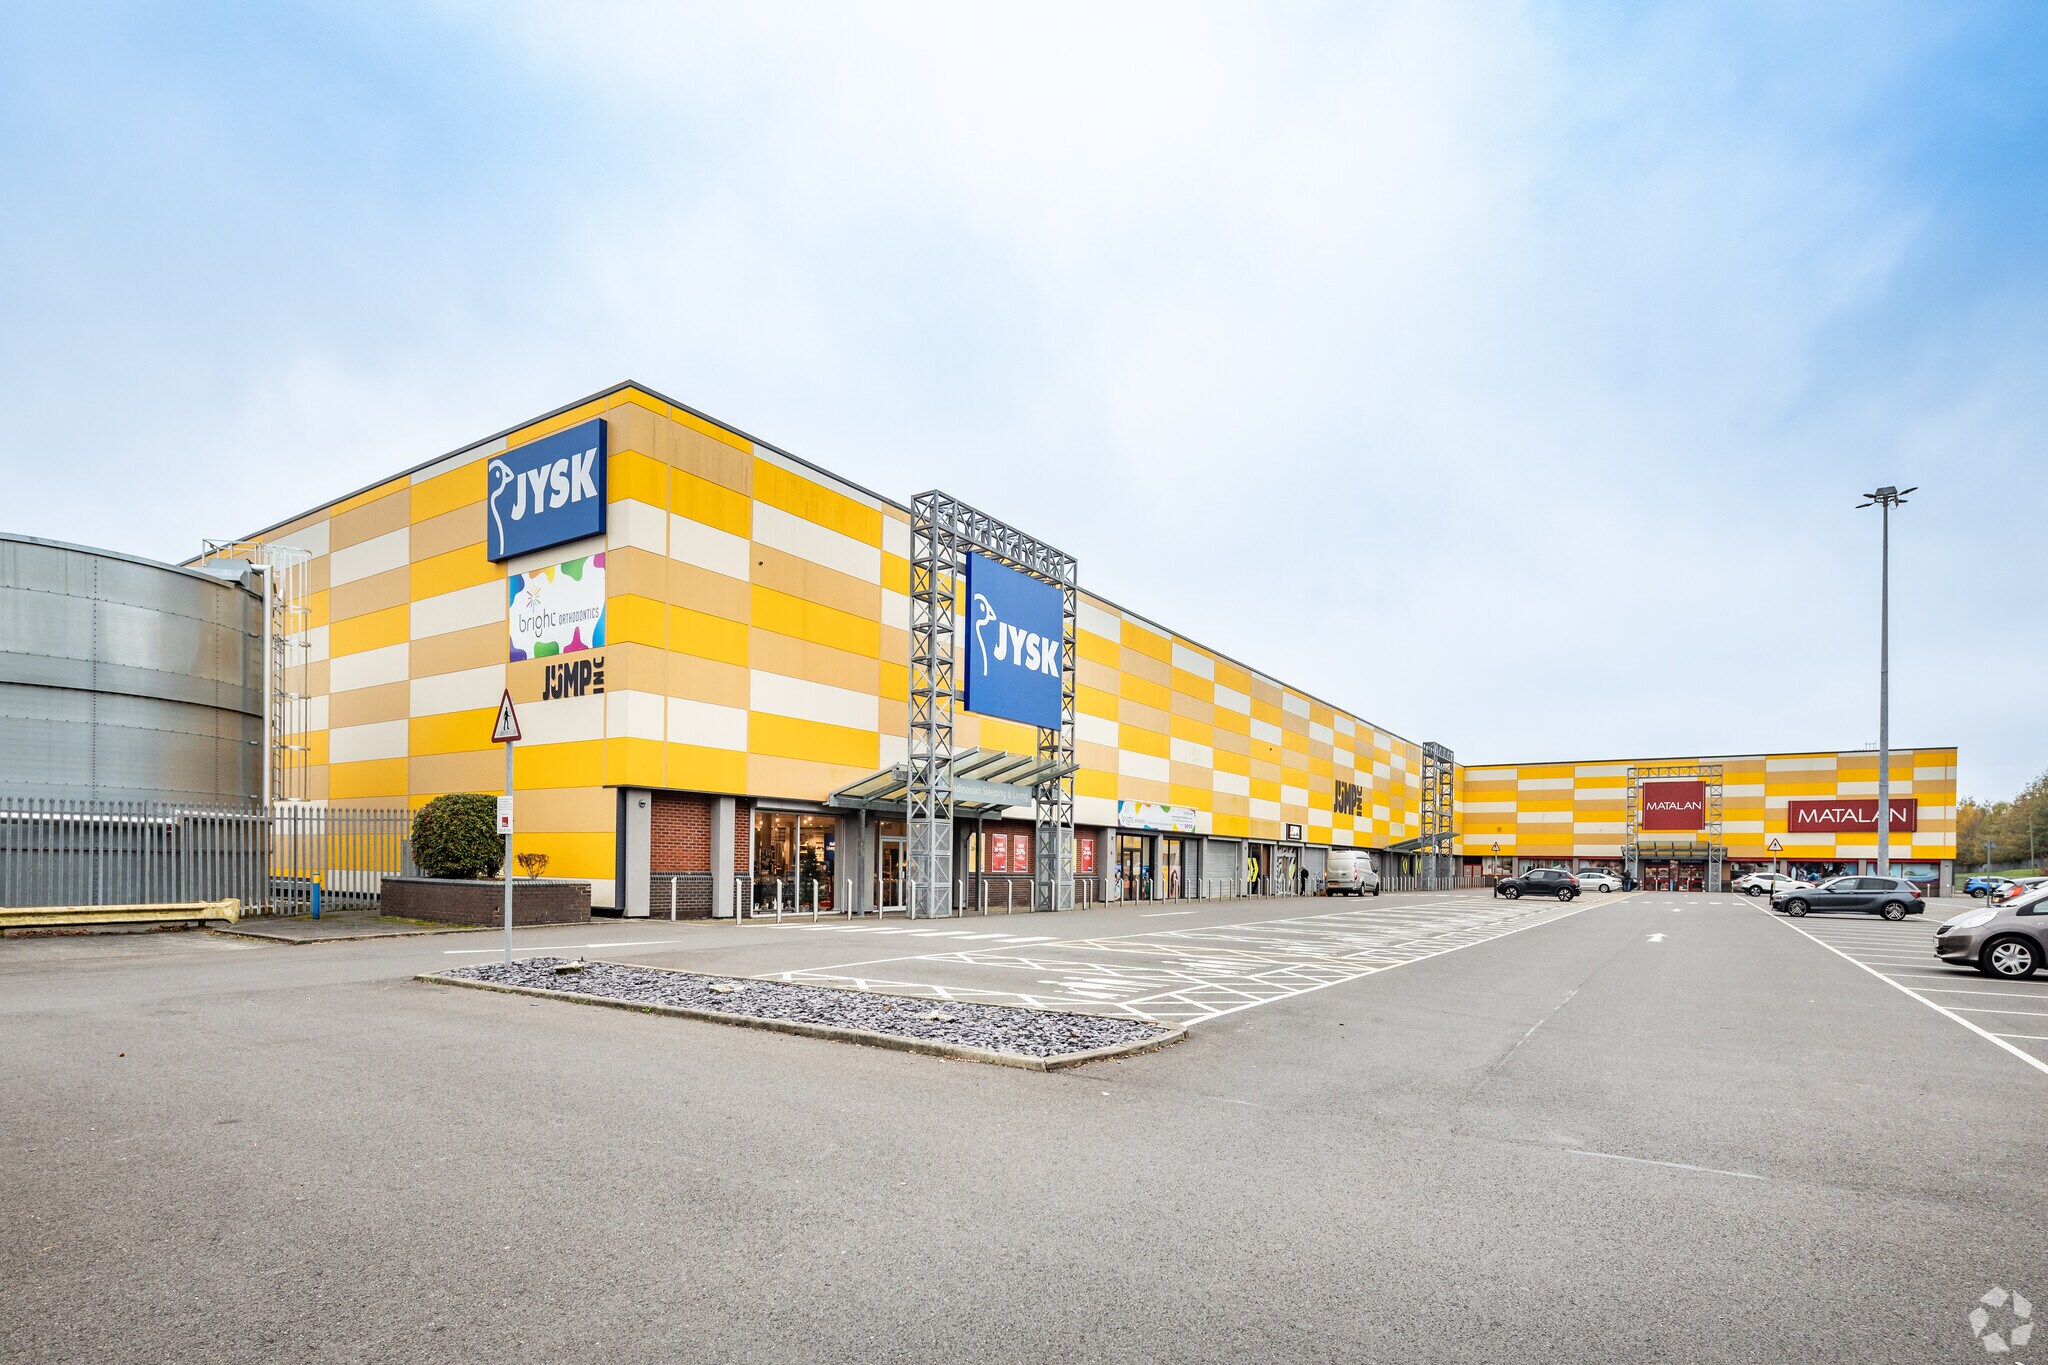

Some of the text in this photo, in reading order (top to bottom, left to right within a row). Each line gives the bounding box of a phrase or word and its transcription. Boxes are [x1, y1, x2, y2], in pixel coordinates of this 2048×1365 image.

[511, 447, 598, 520] JYSK
[519, 607, 599, 638] bright ORTHODONTICS
[993, 621, 1060, 678] JYSK
[543, 659, 592, 701] JUMP
[593, 656, 605, 694] INC
[943, 783, 982, 795] Sndinavian
[983, 786, 1006, 800] Sleeping
[1013, 791, 1029, 802] Living
[1334, 780, 1356, 815] JUMP
[1646, 801, 1702, 811] MATALAN
